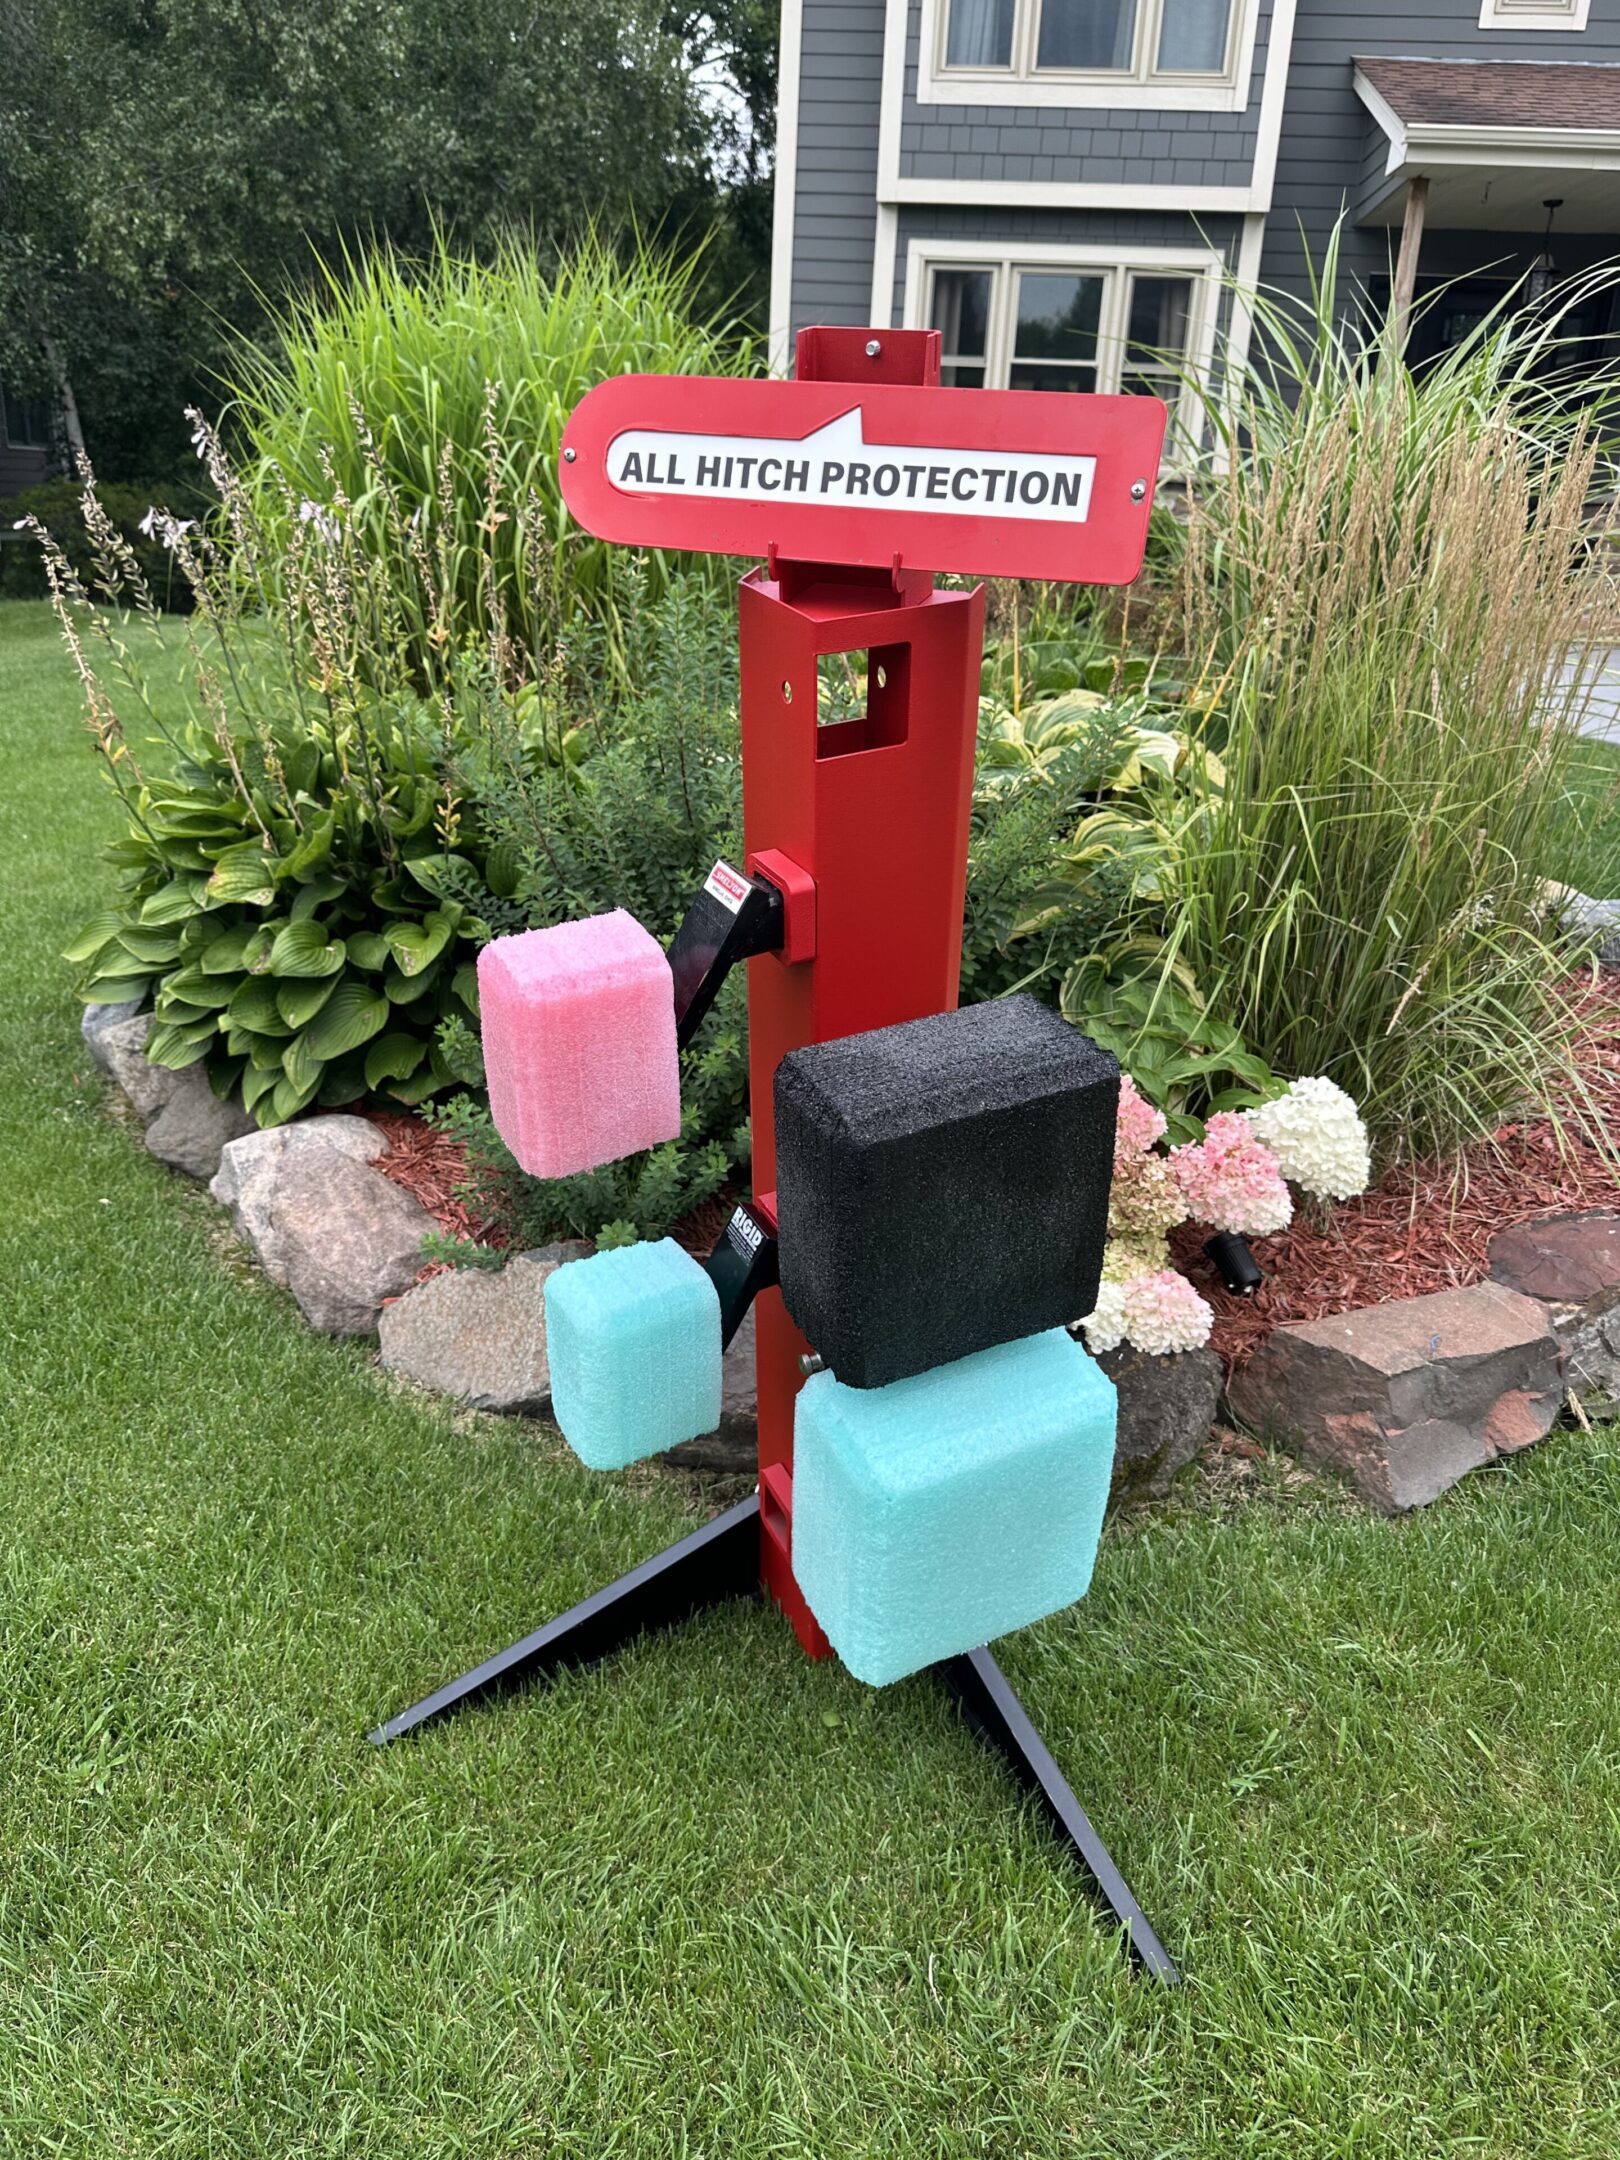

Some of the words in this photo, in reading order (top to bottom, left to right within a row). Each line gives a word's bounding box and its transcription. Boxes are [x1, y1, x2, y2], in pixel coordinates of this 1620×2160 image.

[620, 452, 685, 485] ALL
[696, 455, 810, 492] HITCH
[820, 461, 1082, 507] PROTECTION
[731, 1206, 763, 1246] RIGID
